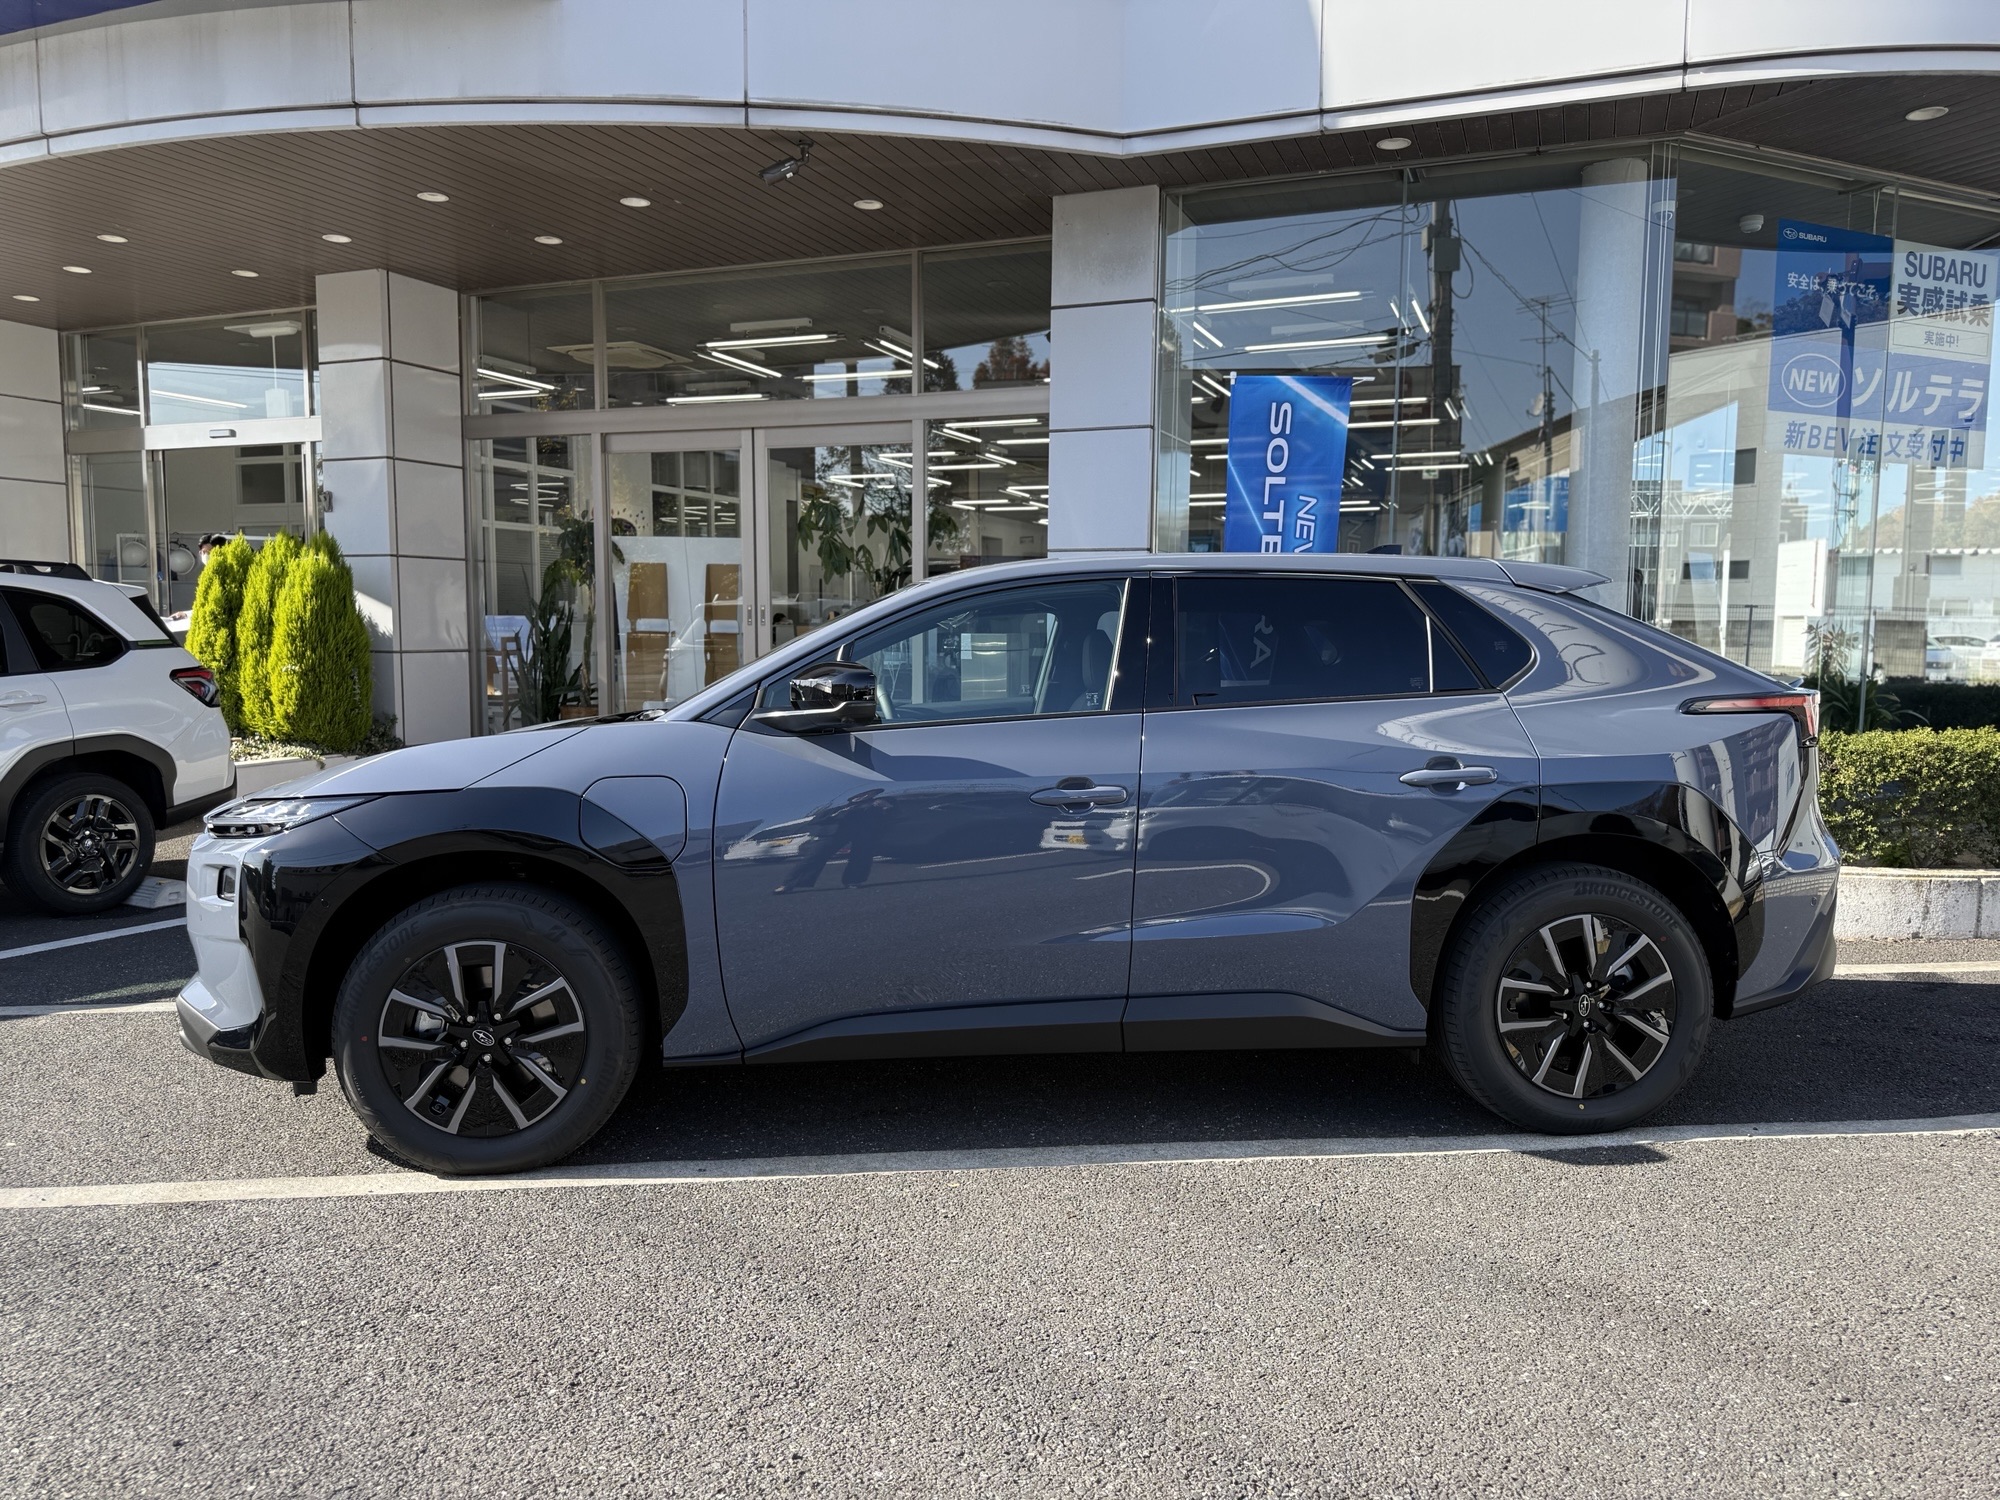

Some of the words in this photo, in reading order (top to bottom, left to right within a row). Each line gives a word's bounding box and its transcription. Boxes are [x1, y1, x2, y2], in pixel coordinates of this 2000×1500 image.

[1798, 232, 1828, 243] SUBARU
[1904, 251, 1987, 289] SUBARU
[1896, 282, 1990, 328] 実感試乗
[1789, 368, 1840, 395] NEW
[1851, 366, 1985, 421] ソルテラ
[1783, 420, 1966, 463] 新BEV注文受付中
[1294, 495, 1318, 554] NE
[1572, 881, 1680, 931] BRIDGESTONE
